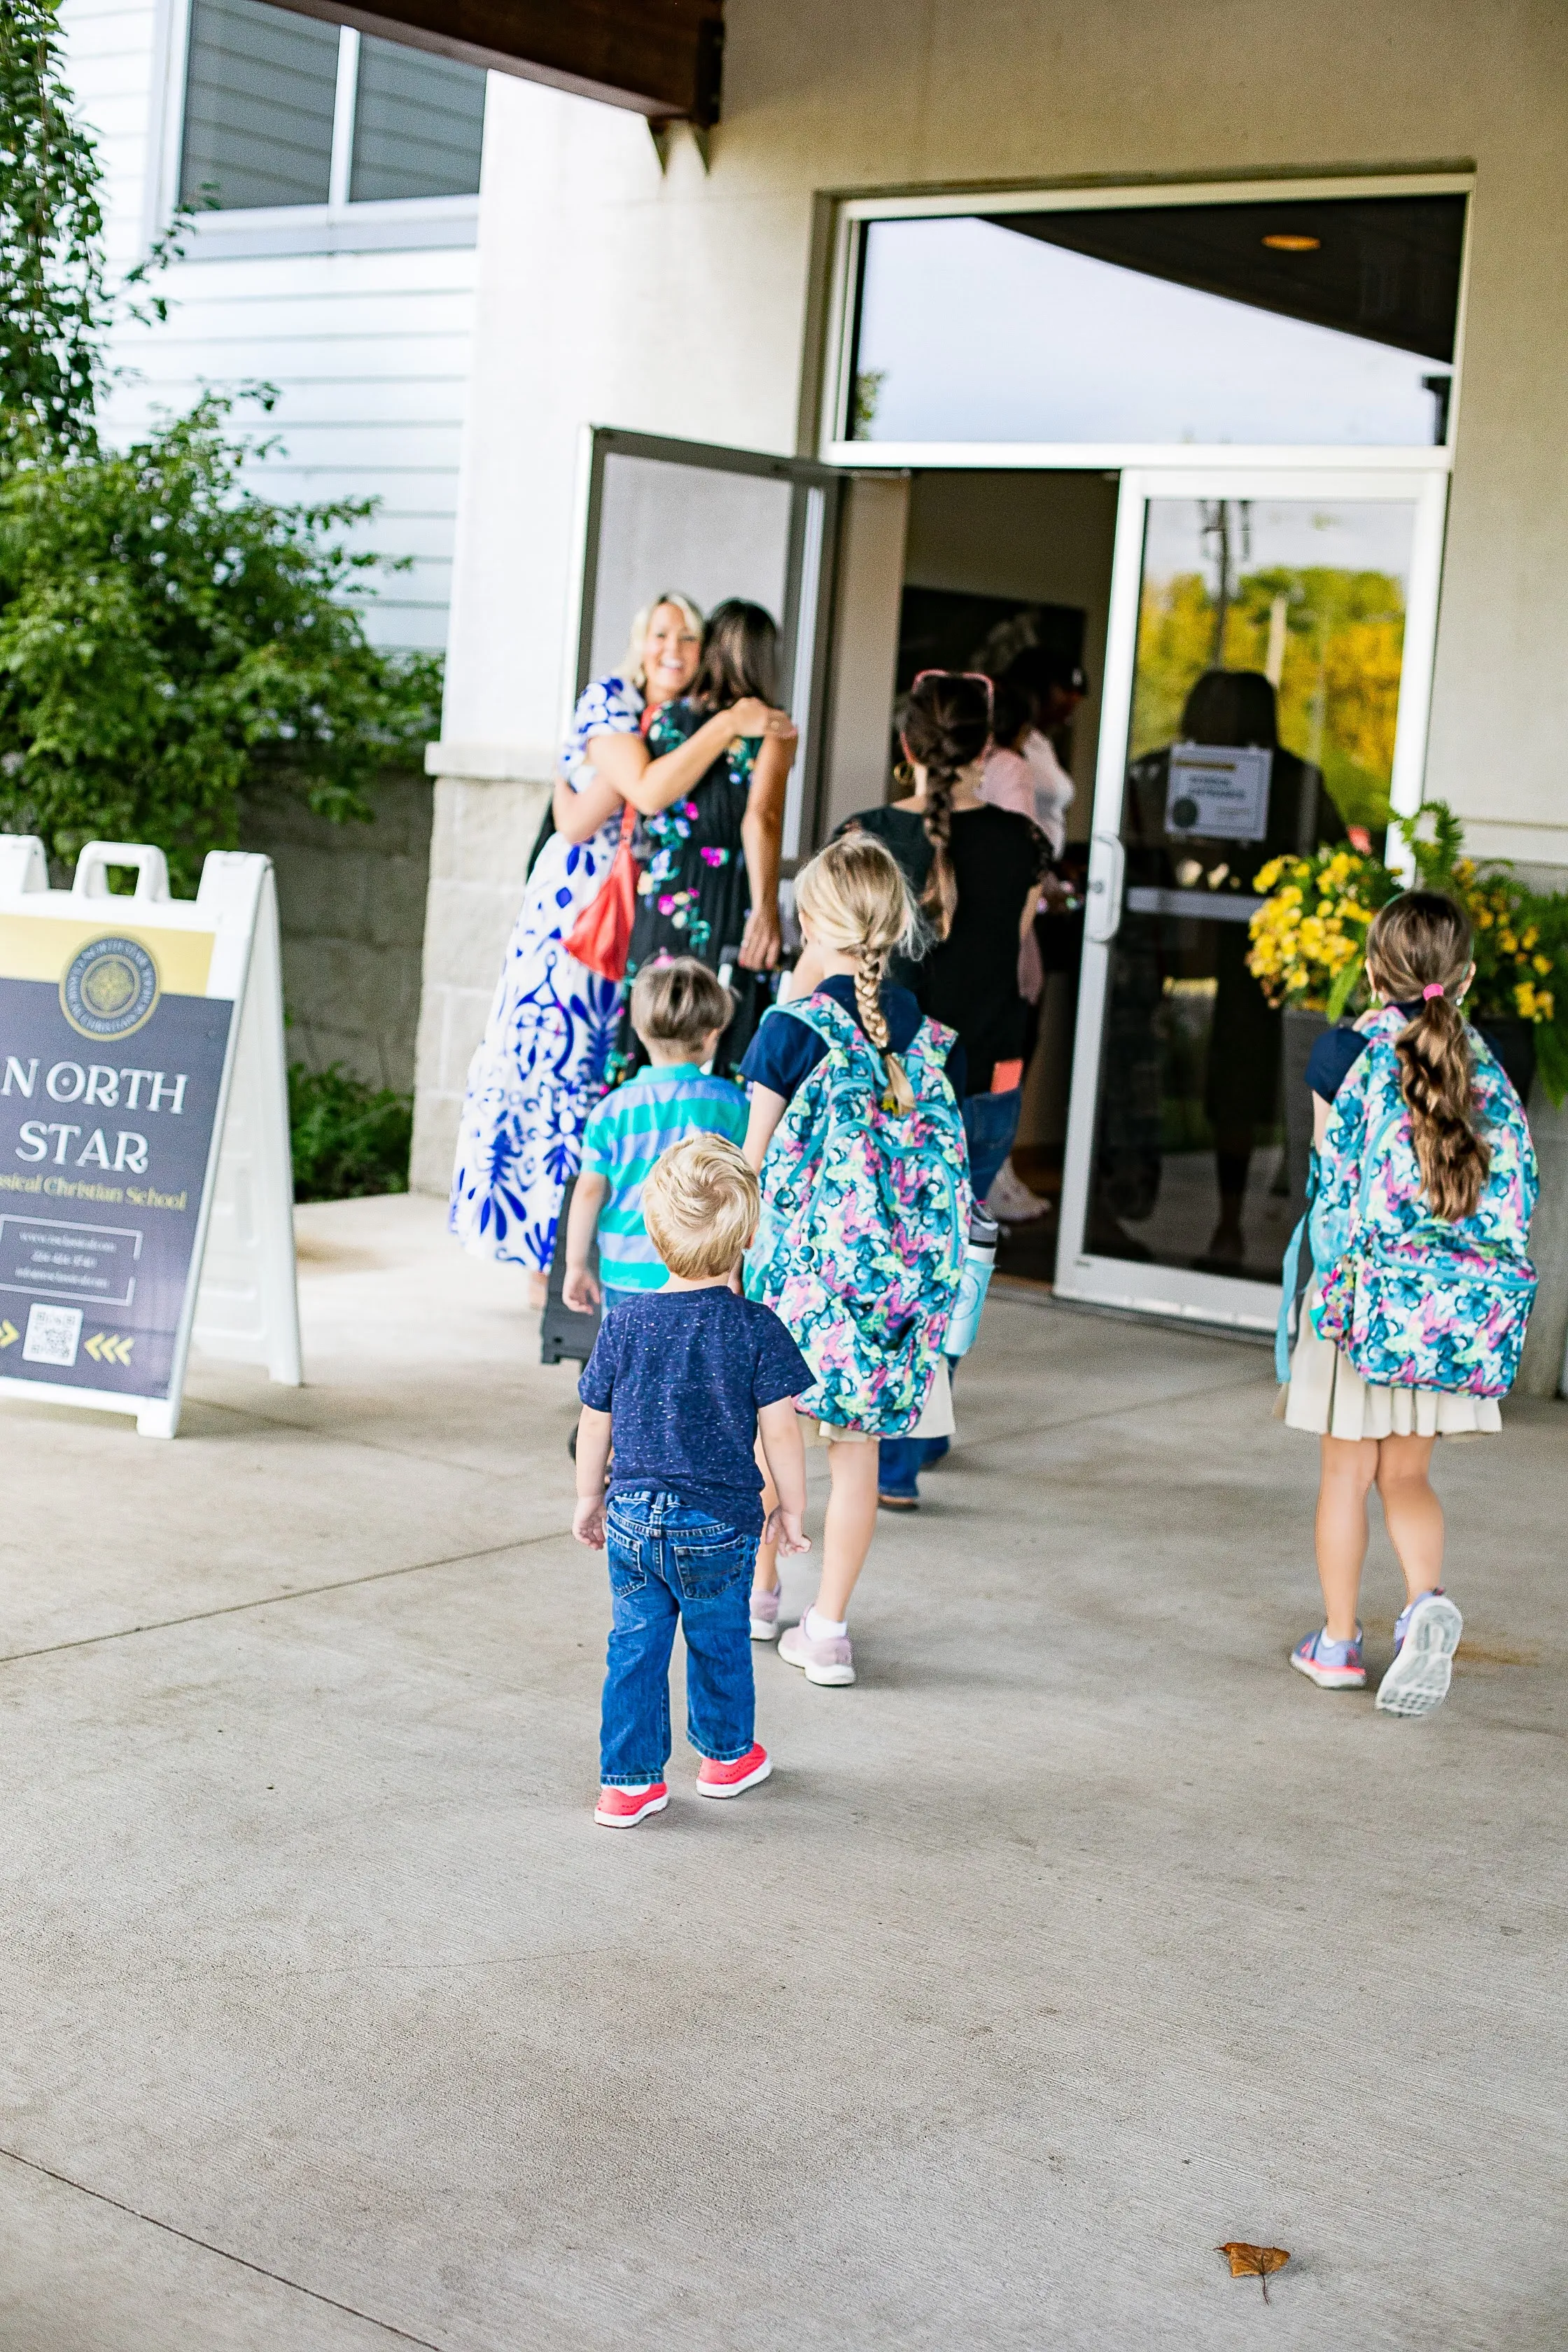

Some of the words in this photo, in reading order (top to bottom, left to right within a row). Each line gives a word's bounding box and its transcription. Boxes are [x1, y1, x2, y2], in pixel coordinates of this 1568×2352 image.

[1, 1056, 189, 1114] NORTH
[15, 1120, 148, 1174] STAR
[43, 1175, 124, 1203] Christian
[126, 1186, 188, 1211] School
